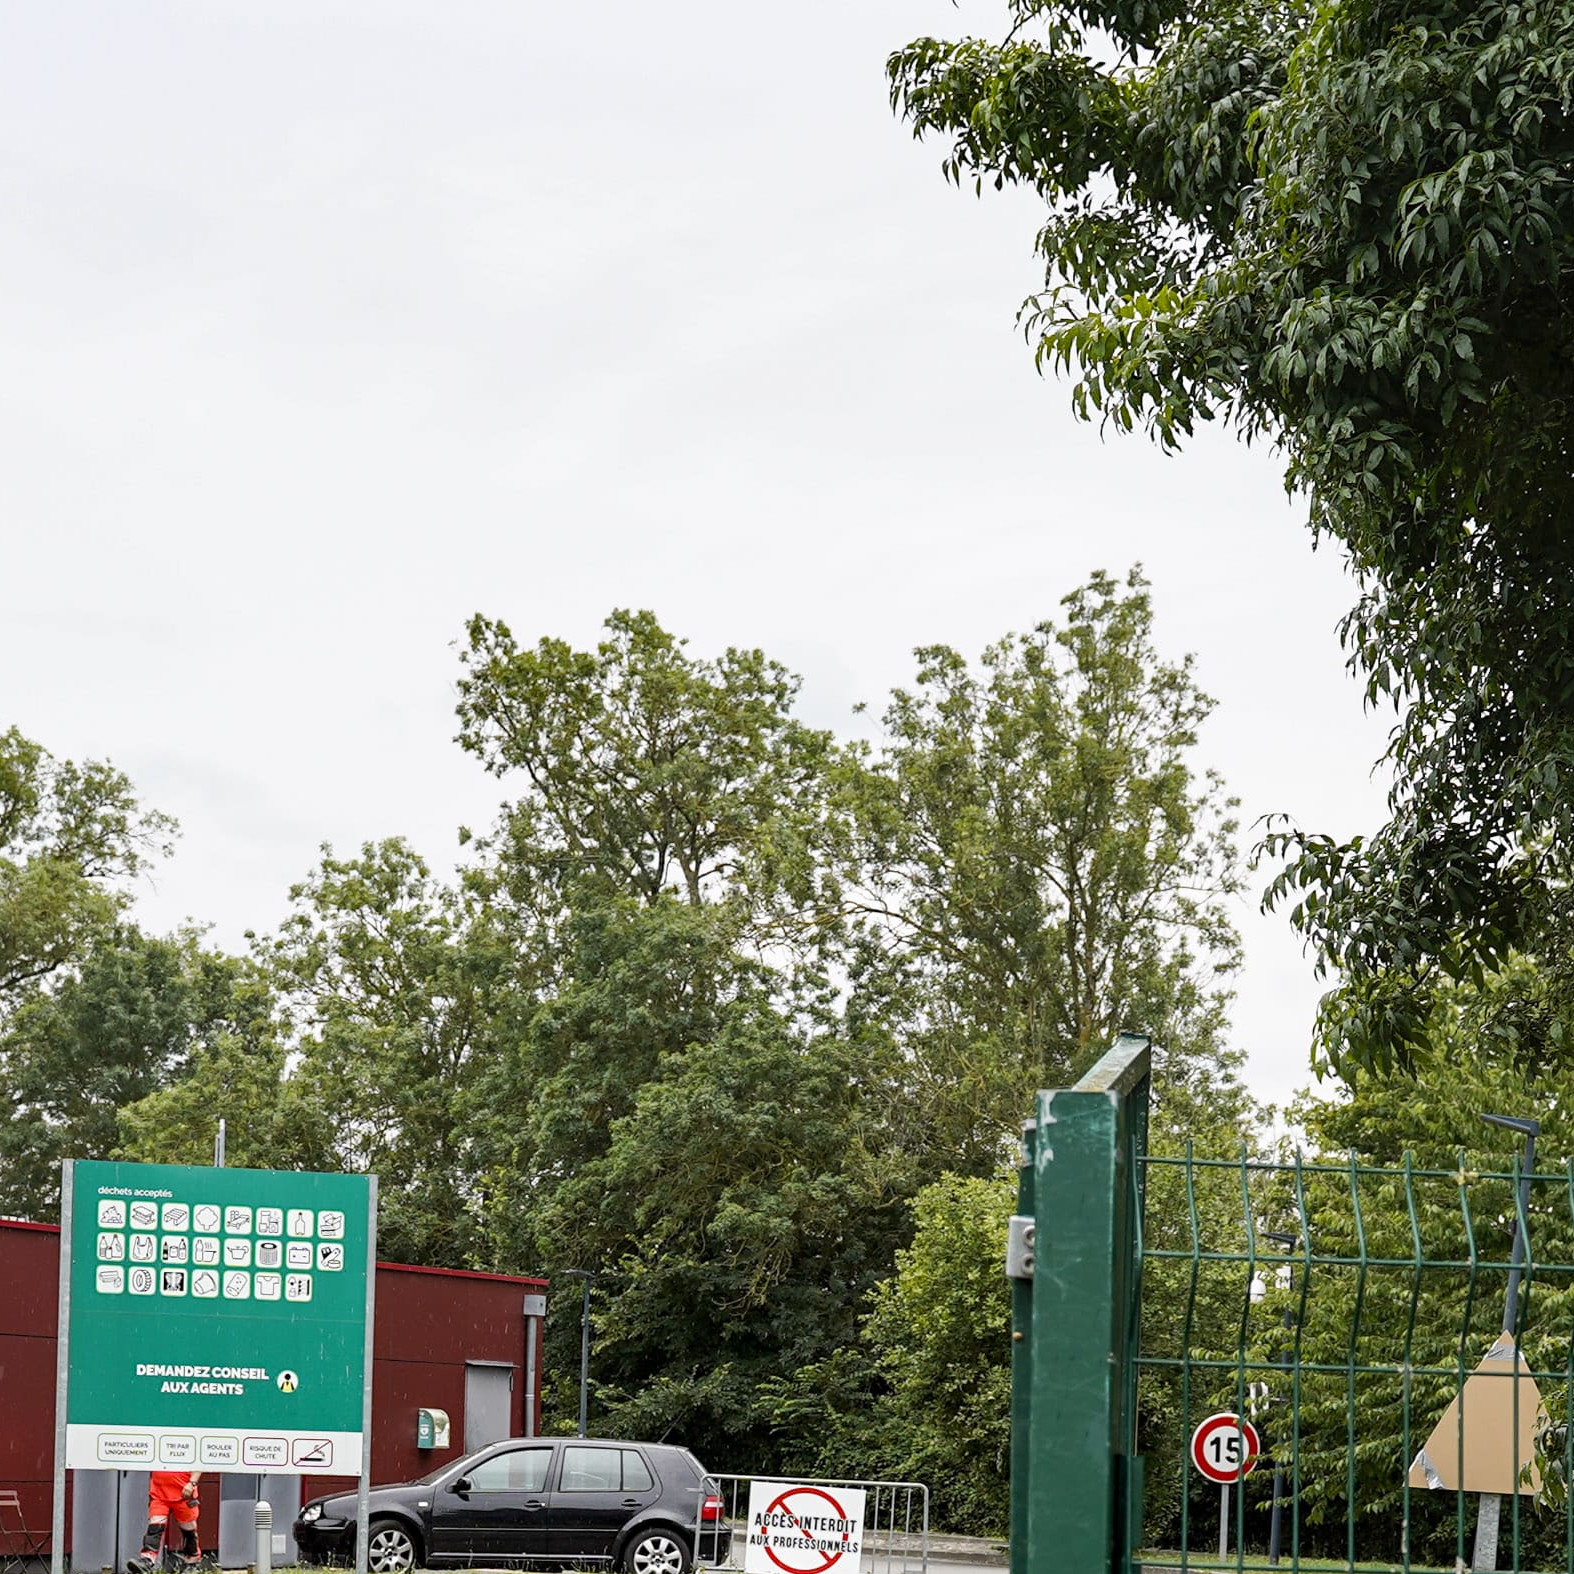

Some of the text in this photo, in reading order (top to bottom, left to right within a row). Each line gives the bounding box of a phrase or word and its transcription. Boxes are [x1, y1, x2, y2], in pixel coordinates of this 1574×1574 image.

[98, 1186, 173, 1198] déchets acceptés
[136, 1364, 269, 1379] DEMANDEZ CONSEIL
[161, 1381, 243, 1395] AUX AGENTS
[1210, 1437, 1241, 1463] 15
[755, 1512, 857, 1533] ACCÈS INTERDIT
[750, 1534, 858, 1552] AUX PROFESSIONNELS
